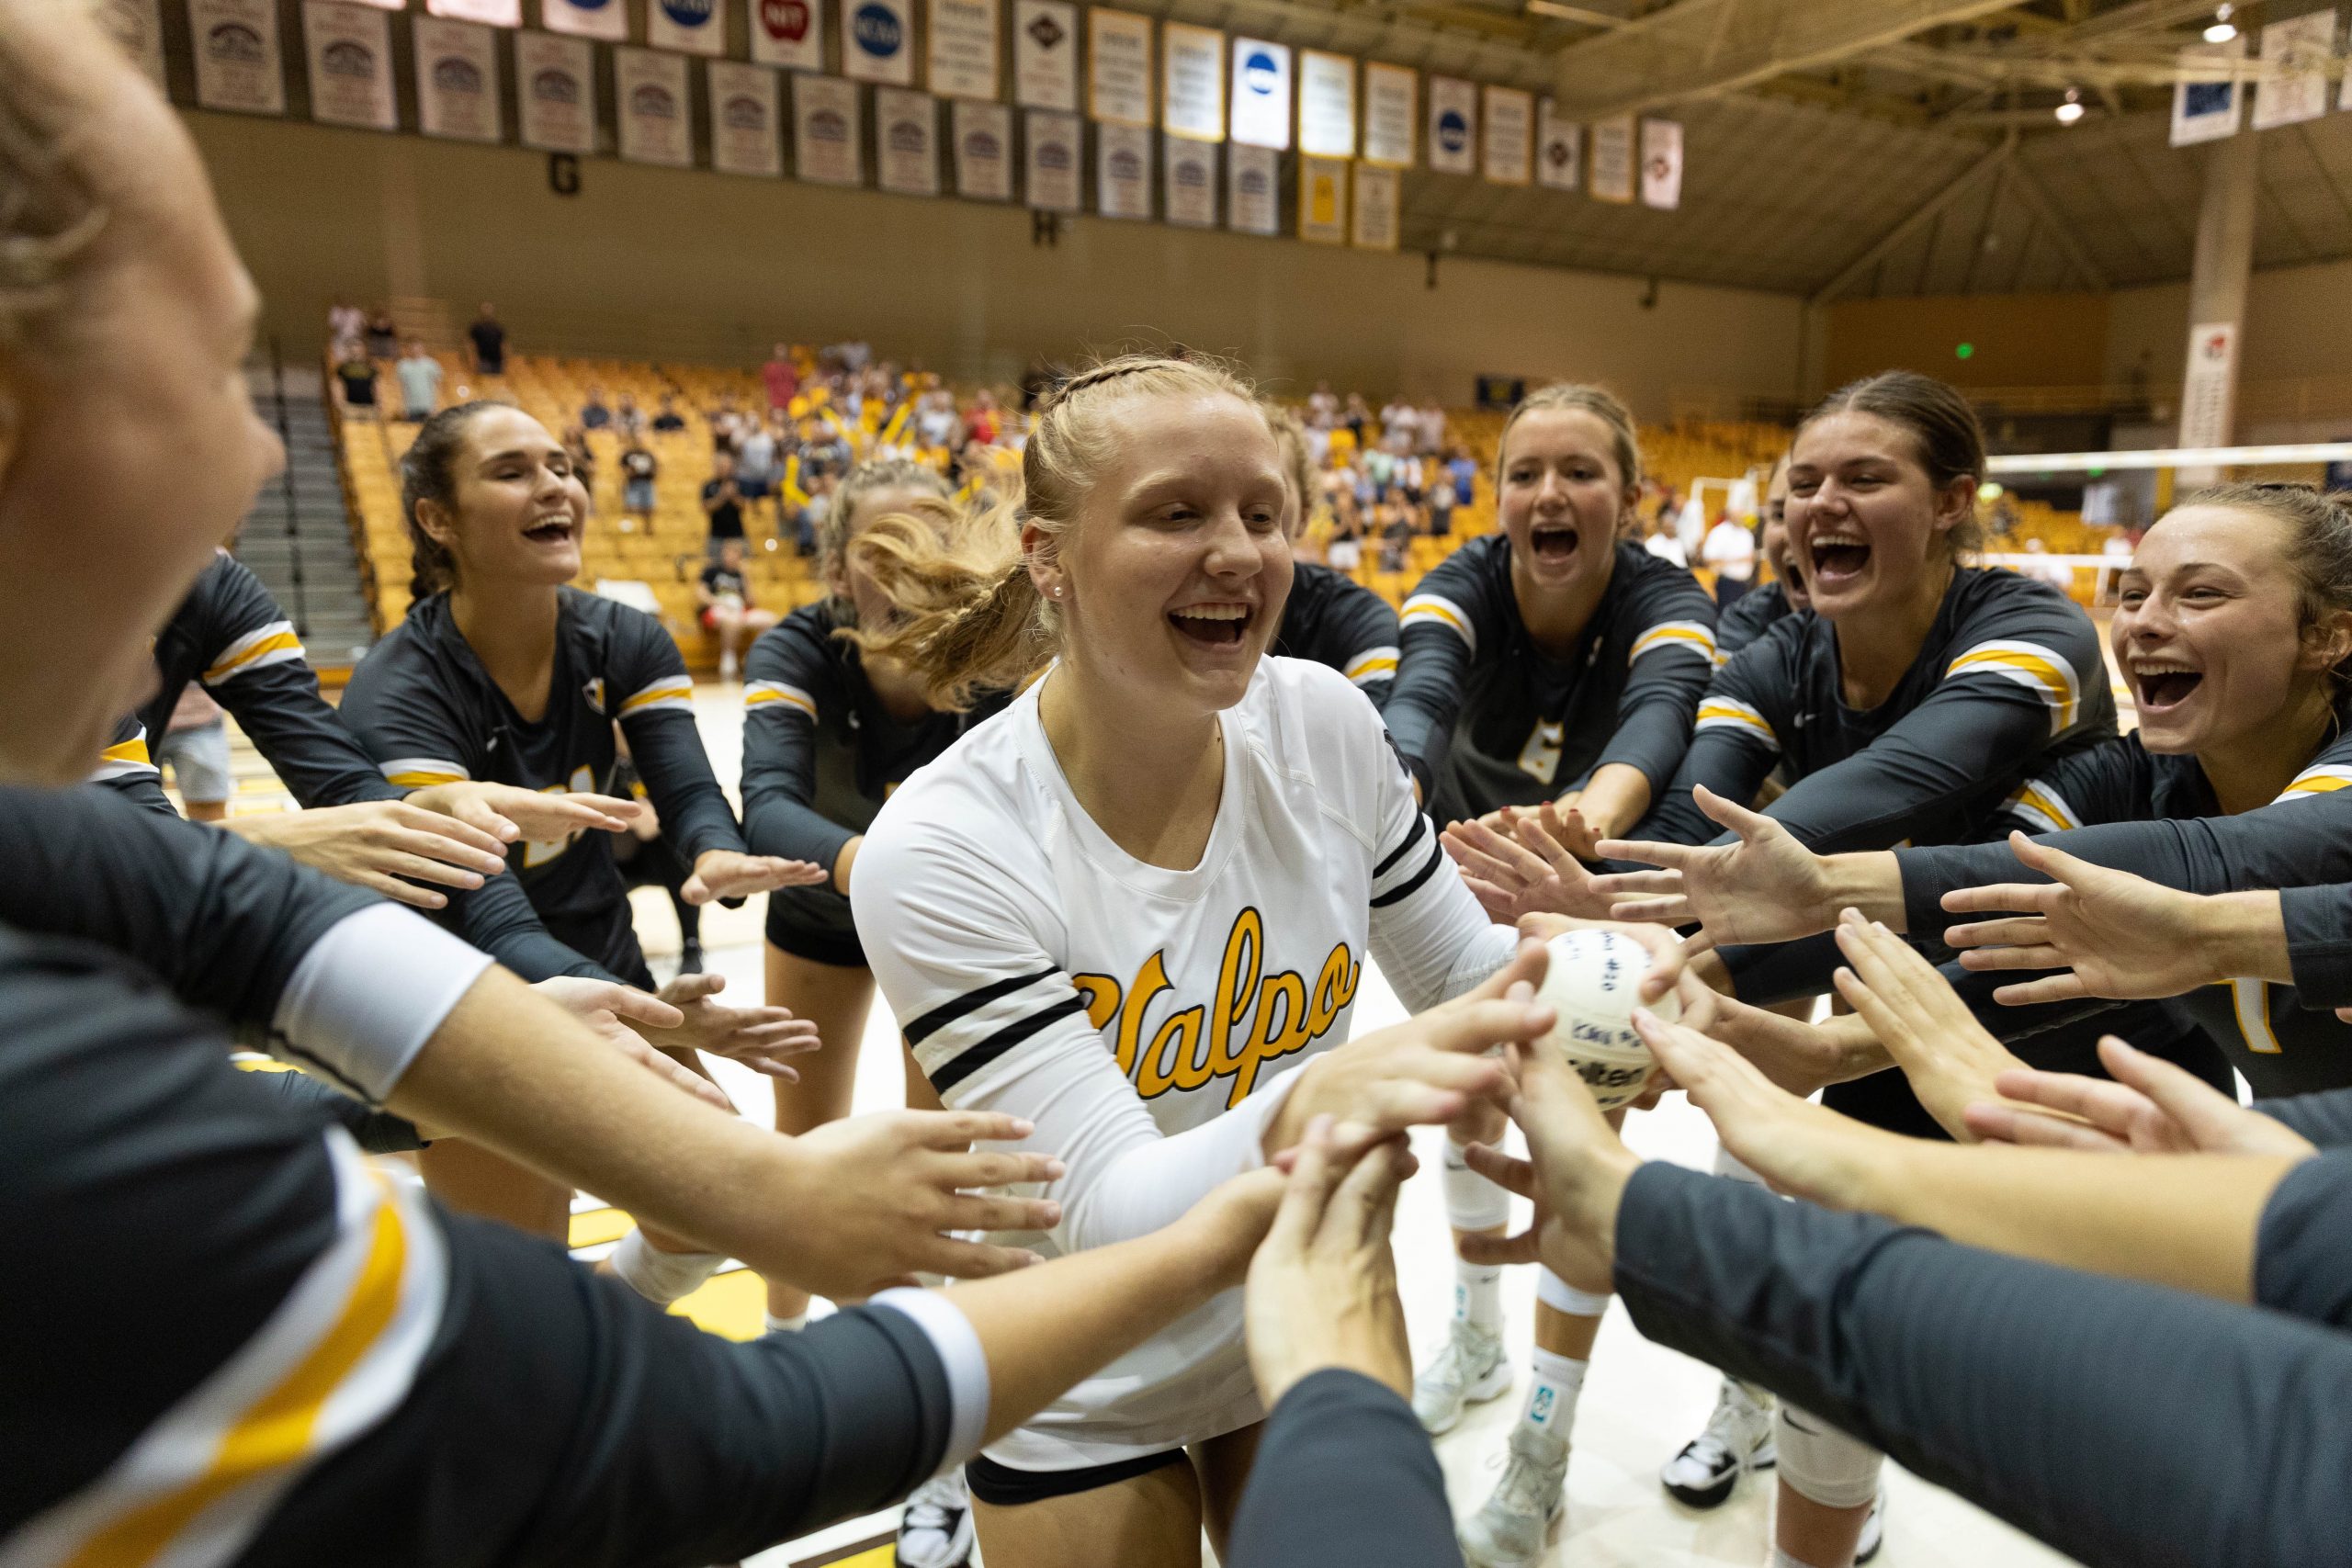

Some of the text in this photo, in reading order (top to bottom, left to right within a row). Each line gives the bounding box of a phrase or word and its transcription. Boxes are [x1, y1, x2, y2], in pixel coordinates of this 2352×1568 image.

[549, 152, 580, 194] G
[1033, 209, 1059, 245] H
[1072, 905, 1361, 1111] Valpo
